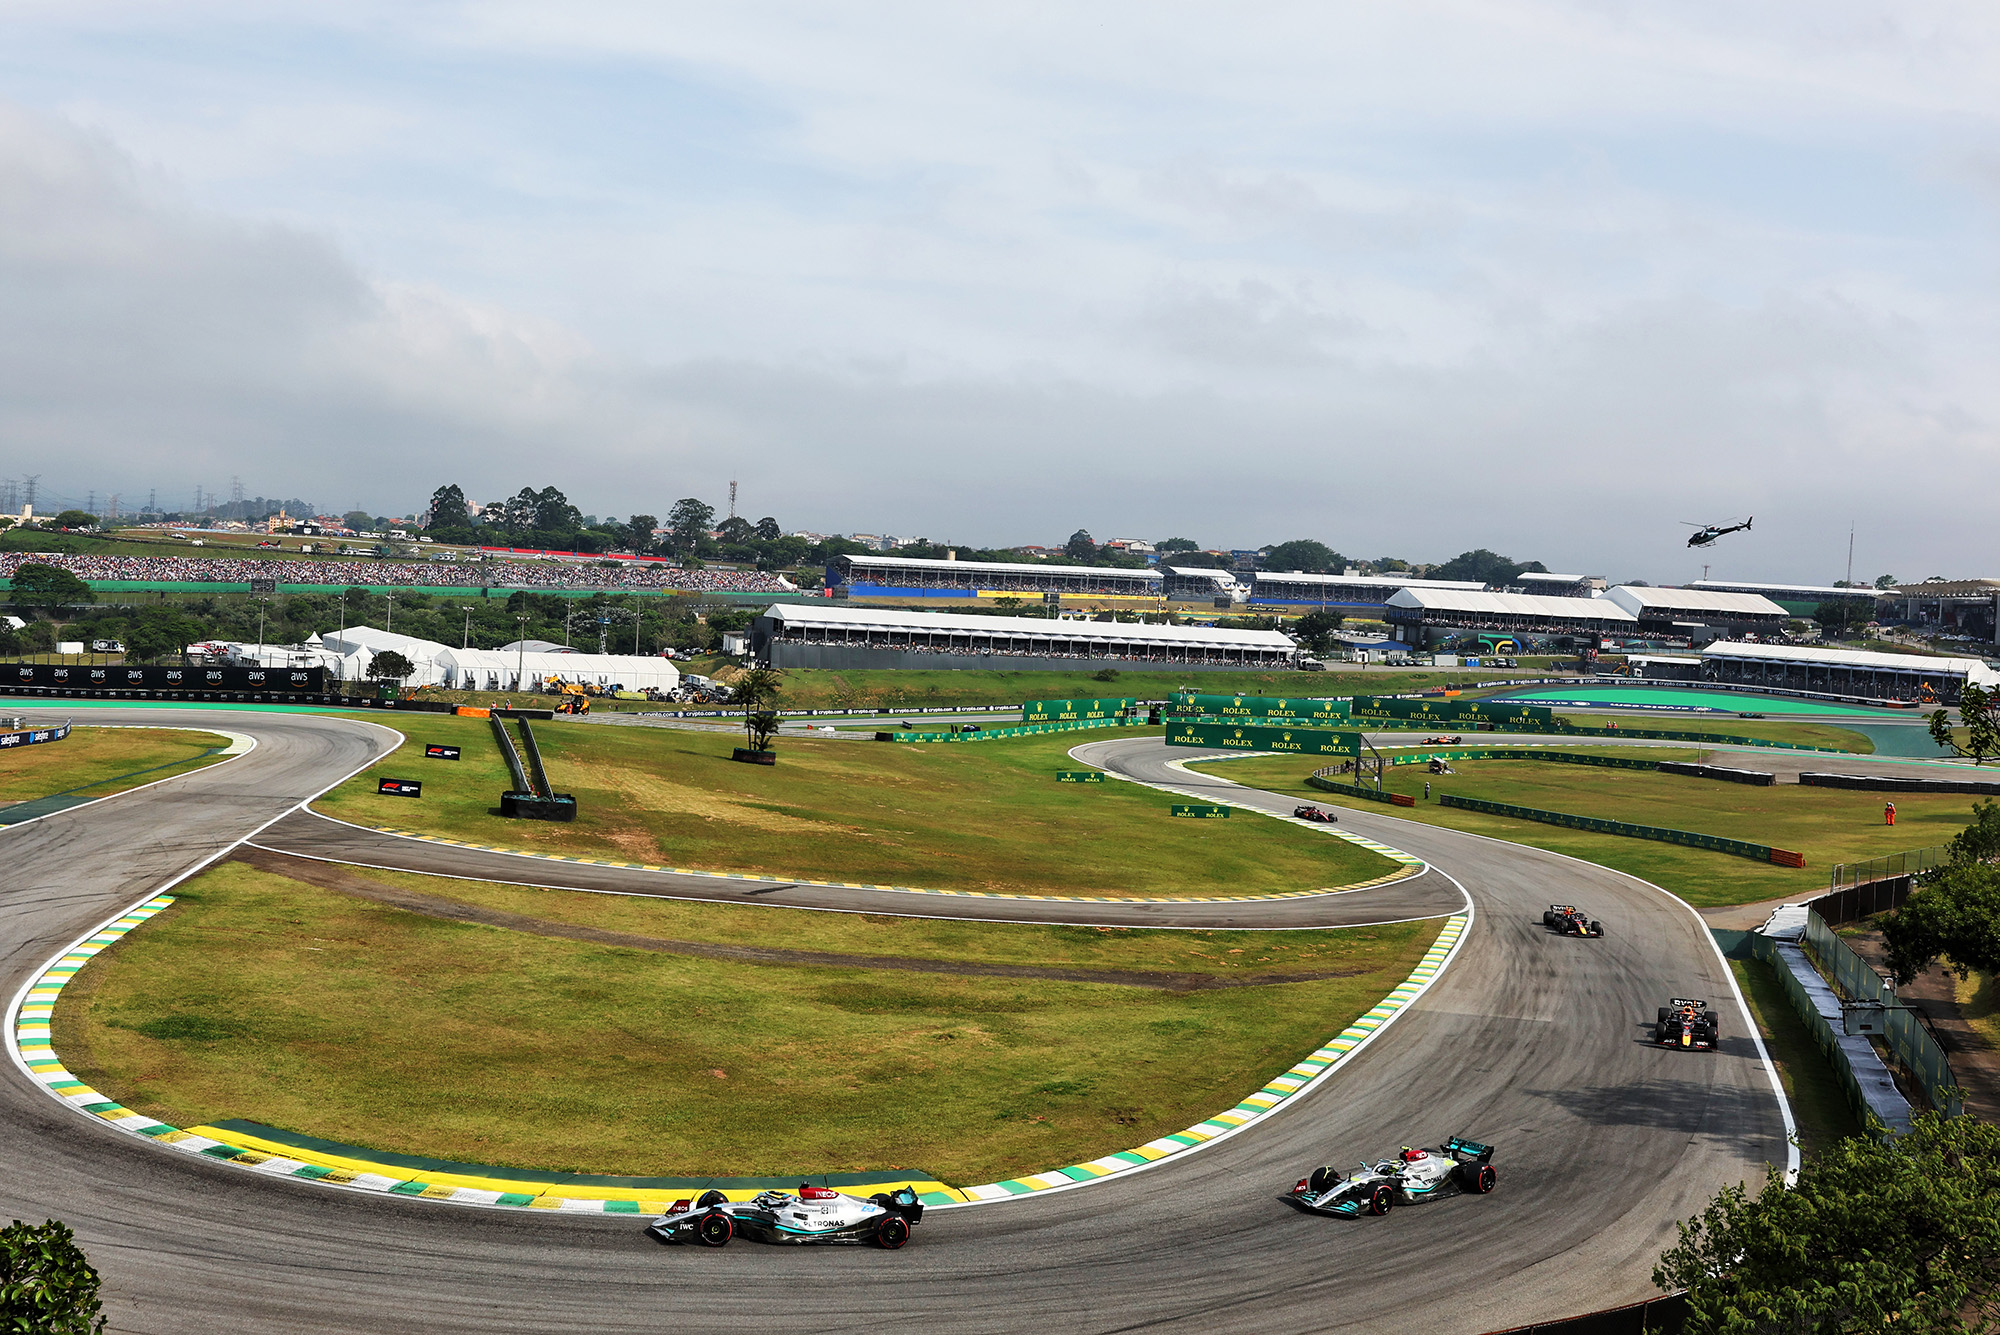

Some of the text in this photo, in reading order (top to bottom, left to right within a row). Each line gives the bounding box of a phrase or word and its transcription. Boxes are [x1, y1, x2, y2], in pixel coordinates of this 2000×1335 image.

[20, 668, 33, 676] aws
[54, 669, 68, 677] aws
[91, 670, 105, 678] aws
[128, 670, 142, 679] aws
[167, 671, 182, 679] aws
[206, 671, 222, 680] aws
[249, 672, 265, 680] aws
[291, 672, 308, 681] aws
[1410, 712, 1440, 721] ROLEX
[1509, 717, 1541, 725] ROLEX
